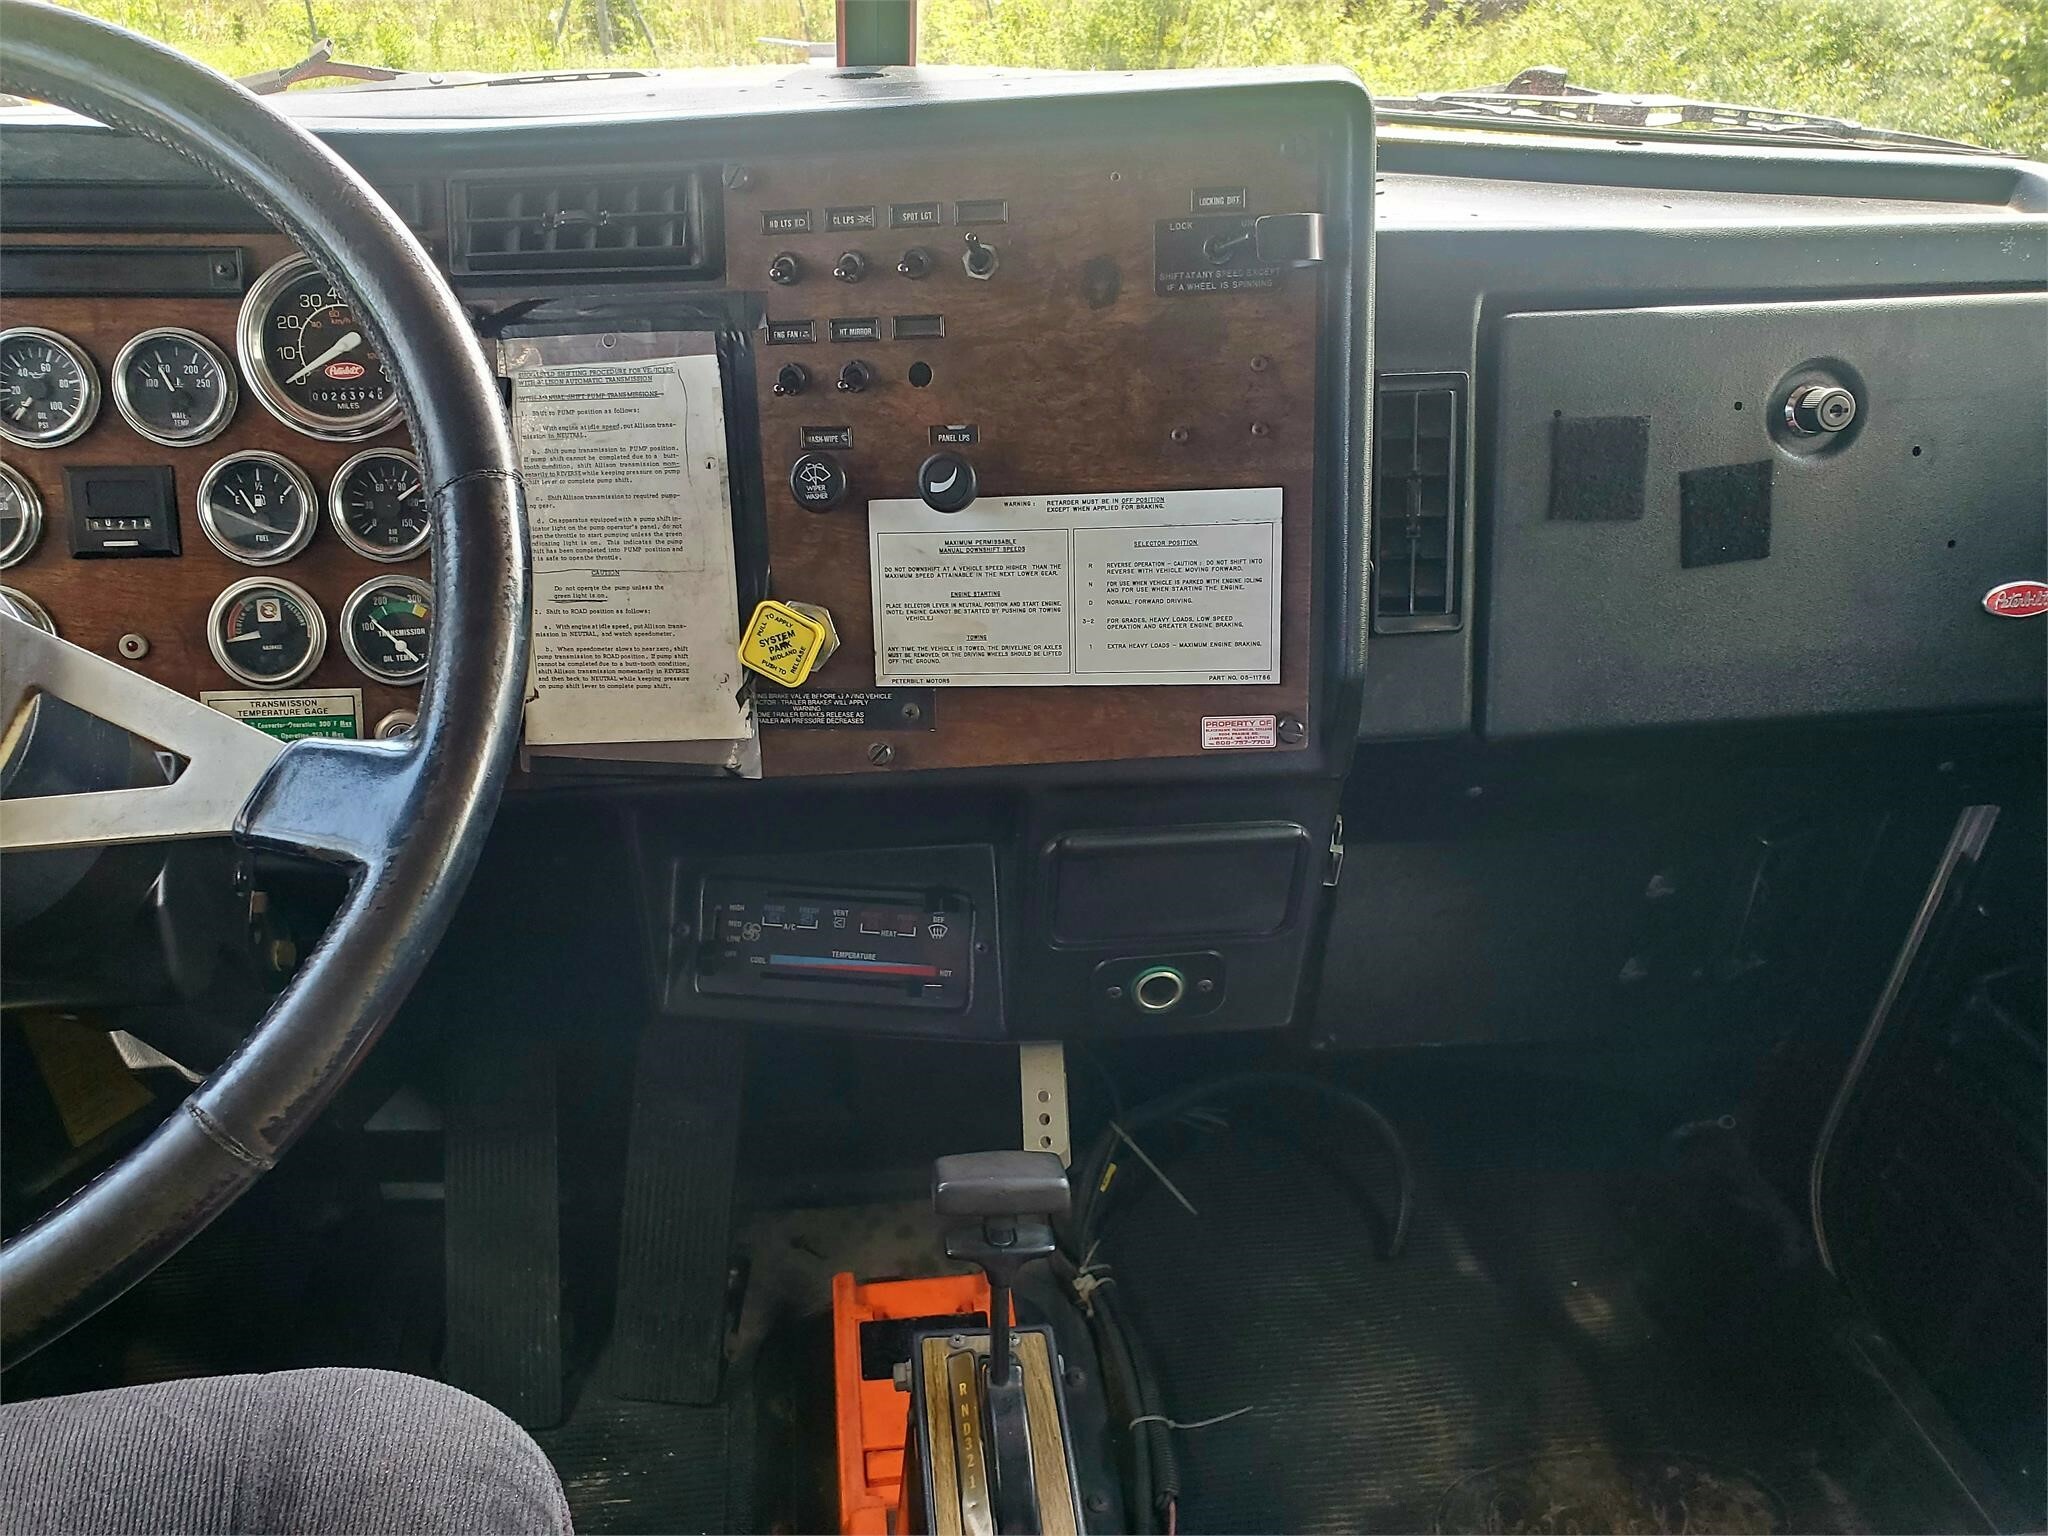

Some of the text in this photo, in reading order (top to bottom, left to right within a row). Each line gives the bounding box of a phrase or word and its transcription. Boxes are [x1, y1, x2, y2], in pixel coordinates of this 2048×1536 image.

[1199, 197, 1224, 205] LOCKING
[833, 215, 854, 224] CL LPS
[903, 212, 932, 221] SPOT LGT
[781, 219, 792, 228] LTS
[1170, 222, 1192, 230] LOCK
[1160, 272, 1184, 280] SHIFT
[1187, 282, 1216, 290] WHEEL
[1233, 280, 1273, 288] SPINNING
[300, 295, 321, 307] 30
[277, 316, 298, 328] 20
[849, 327, 872, 335] MIRROR
[277, 347, 295, 359] 10
[41, 363, 50, 372] 60
[184, 365, 198, 374] 200
[17, 368, 28, 377] 40
[59, 380, 69, 388] 80
[196, 379, 210, 388] 250
[50, 402, 62, 410] 100
[38, 412, 47, 420] OIL
[938, 434, 957, 442] PANEL
[375, 483, 384, 492] 60
[397, 482, 406, 491] 90
[235, 496, 240, 505] E
[280, 496, 284, 504] F
[402, 519, 413, 527] 150
[374, 596, 387, 606] 200
[408, 594, 421, 604] 300
[362, 622, 374, 631] 100
[757, 622, 767, 636] PULL
[774, 616, 794, 628] APPLY
[759, 630, 796, 647] SYSTEM
[769, 641, 792, 654] PARK
[383, 654, 394, 663] OIL
[770, 649, 797, 661] MIDLAND
[762, 647, 806, 675] PUSH TO RELEASE
[250, 700, 317, 708] TRANSMISSION
[238, 707, 329, 717] TEMPERATURE GAGE
[833, 909, 849, 917] VENT
[832, 951, 876, 961] TEMPERATURE
[959, 1383, 967, 1395] R
[962, 1404, 969, 1417] N
[964, 1423, 971, 1435] D
[965, 1437, 972, 1450] 3
[967, 1454, 975, 1467] 2
[969, 1476, 976, 1488] 1
